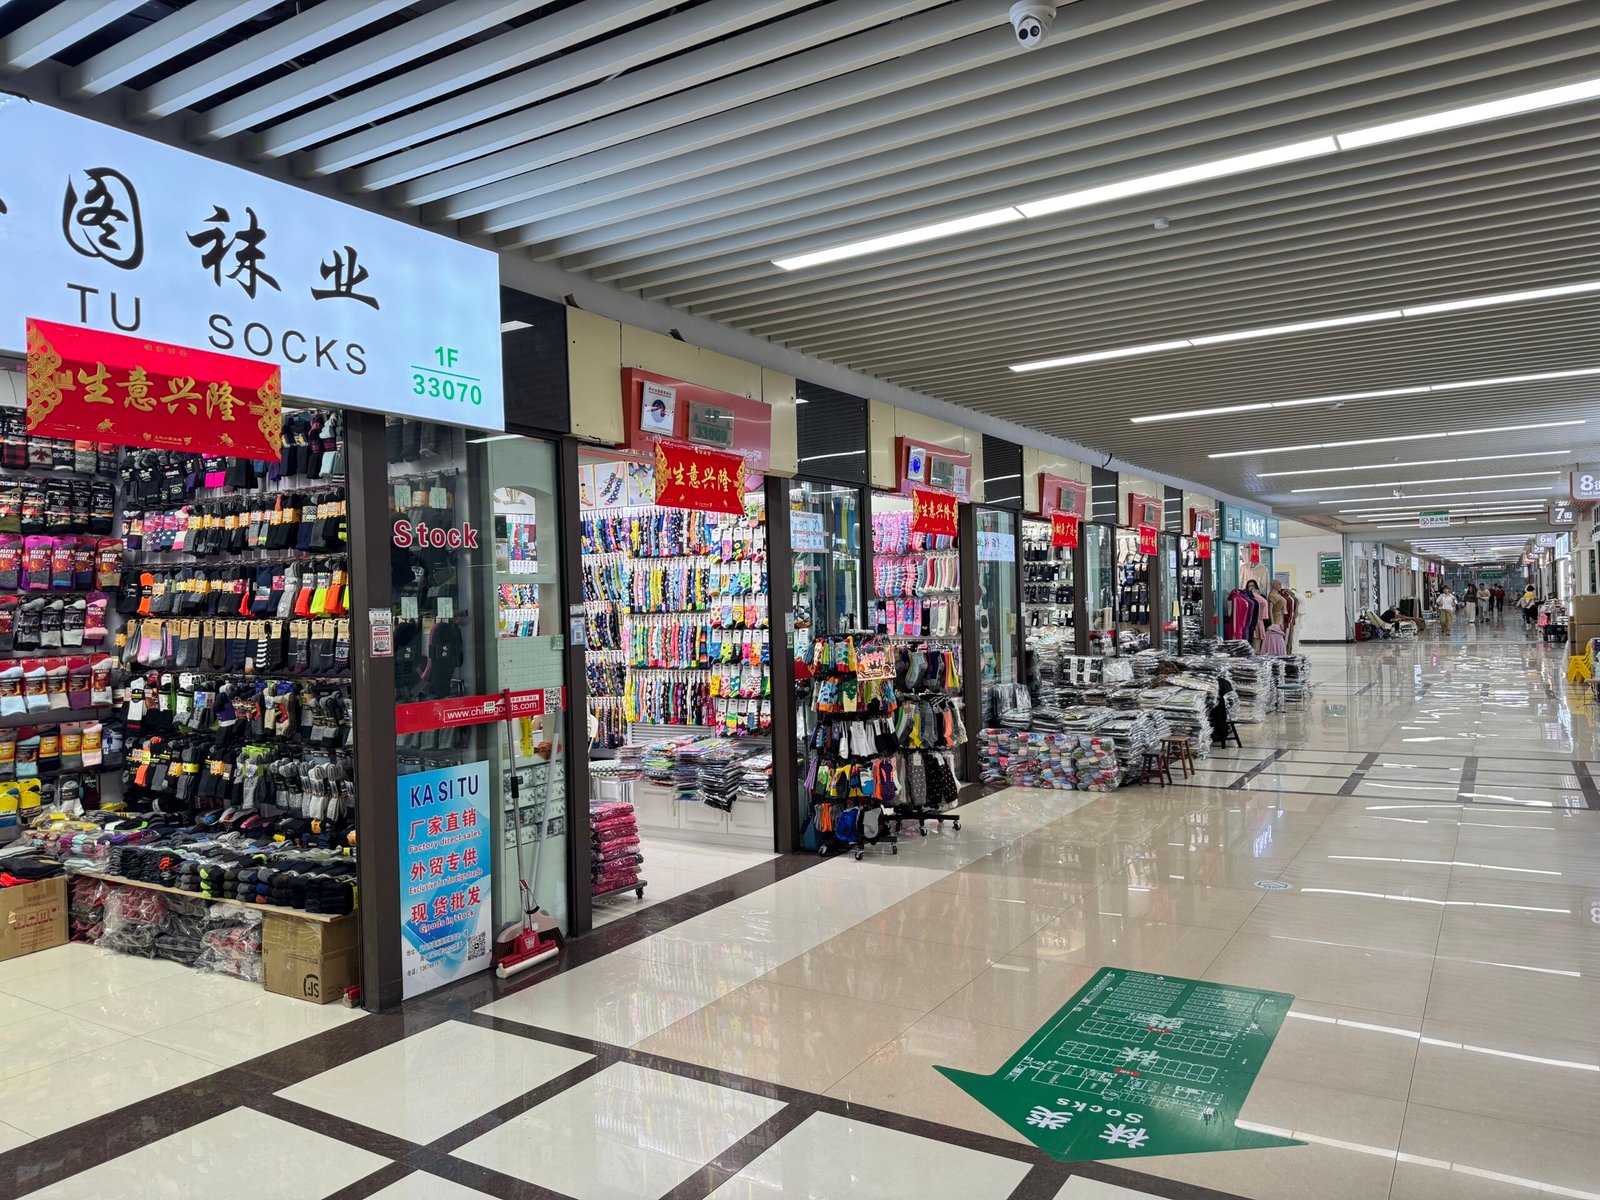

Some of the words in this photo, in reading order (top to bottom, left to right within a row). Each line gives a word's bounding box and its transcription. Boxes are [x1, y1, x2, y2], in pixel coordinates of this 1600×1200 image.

[67, 283, 142, 332] TU
[208, 314, 367, 376] SOCKS
[434, 346, 459, 368] 1F
[76, 361, 245, 422] 生意兴隆
[412, 374, 482, 406] 33070
[671, 461, 732, 493] 生意兴隆
[921, 500, 952, 521] 生意兴隆
[1554, 507, 1573, 520] 7街
[394, 520, 479, 548] Stock
[409, 808, 477, 841] 厂家直销
[409, 841, 439, 853] Factory
[440, 834, 462, 846] direct
[463, 831, 482, 840] sales
[410, 848, 478, 881] 外贸专供
[409, 881, 437, 895] Exclusive
[411, 886, 481, 923] 现货批发
[421, 920, 446, 933] Goods
[455, 910, 475, 921] stock
[1056, 1097, 1144, 1123] Socks
[1026, 1105, 1150, 1149] 袜类
